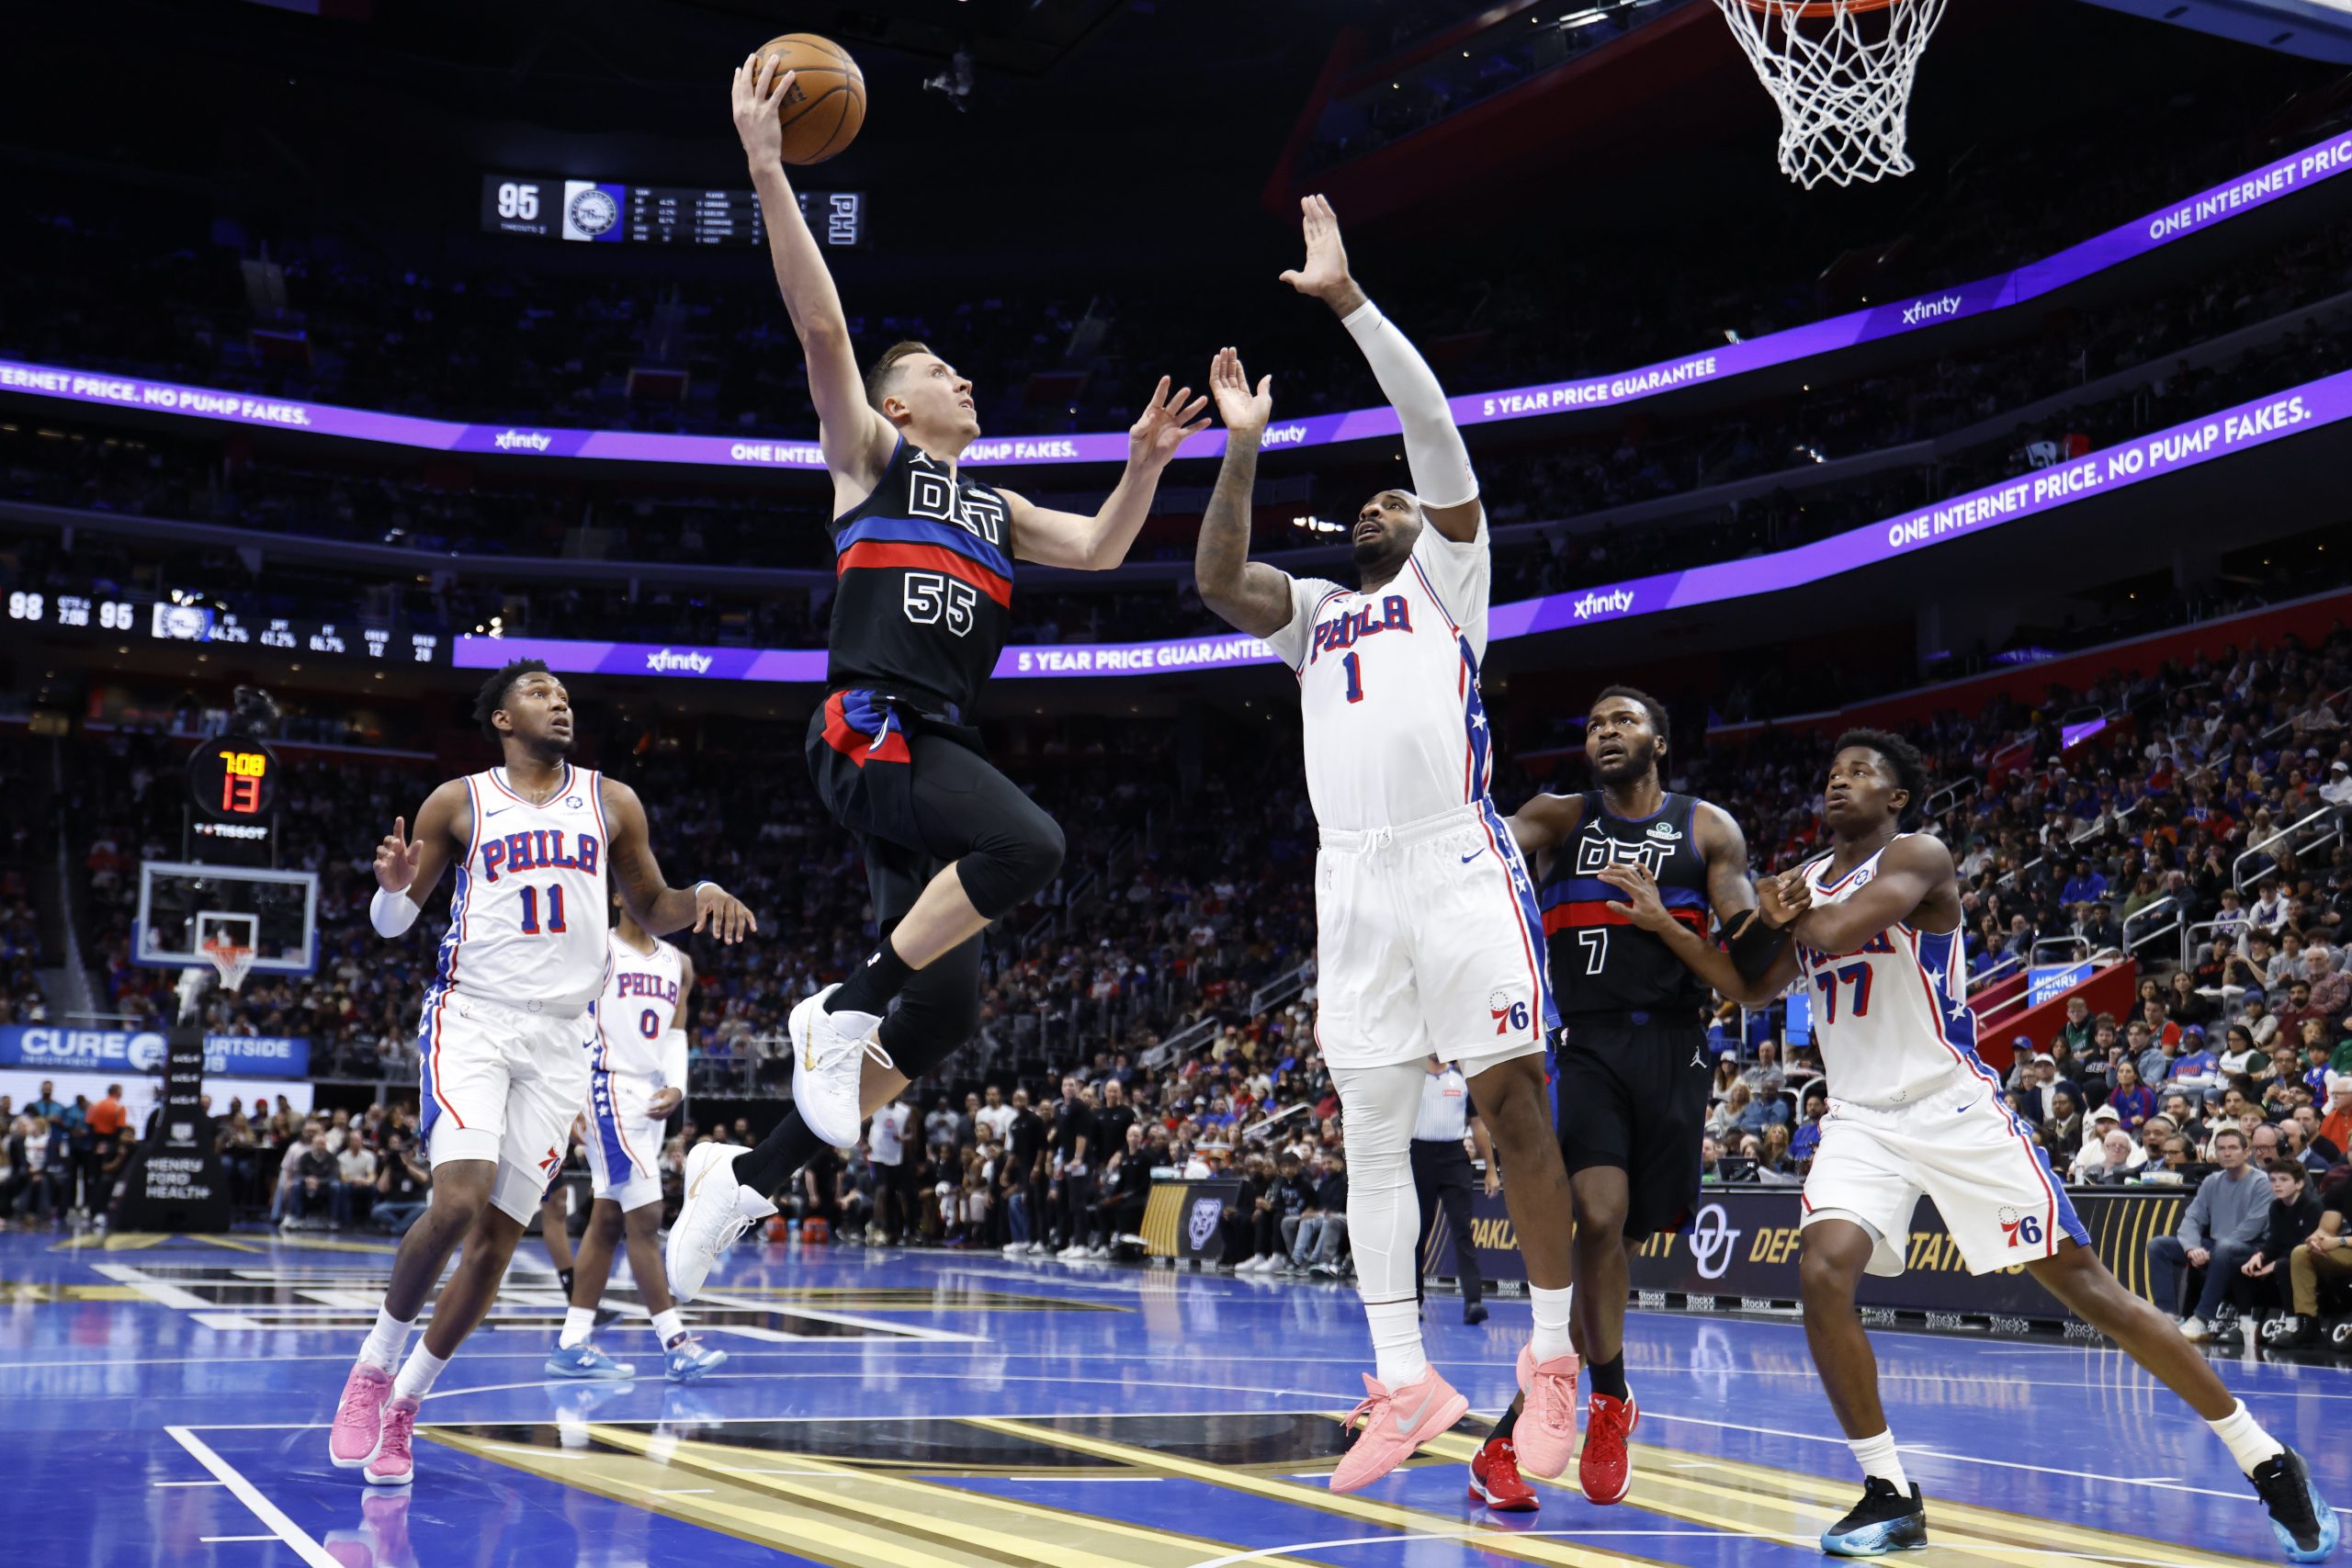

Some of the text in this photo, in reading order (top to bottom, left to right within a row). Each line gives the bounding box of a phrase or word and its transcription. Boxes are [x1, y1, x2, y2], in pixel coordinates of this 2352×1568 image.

[498, 183, 538, 220] 95
[2149, 141, 2352, 240] ONE INTERNET PRIC
[1902, 296, 1961, 324] xfinity
[73, 377, 141, 402] PRICE.
[143, 387, 177, 407] NO
[179, 391, 240, 415] PUMP
[241, 400, 311, 425] FAKES.
[1483, 356, 1716, 416] 5 YEAR PRICE GUARANTEE
[494, 429, 551, 451] xfinity
[730, 443, 772, 461] ONE
[959, 439, 1079, 461] PUMP FAKES.
[1888, 396, 2312, 547] ONE INTERNET PRICE. NO PUMP FAKES.
[9, 592, 43, 620] 98
[100, 602, 133, 629] 95
[904, 572, 977, 637] 55
[1573, 590, 1634, 619] xfinity
[646, 648, 712, 673] xfinity
[1018, 652, 1033, 671] 5
[1035, 651, 1092, 671] YEAR
[1096, 649, 1154, 669] PRICE
[1342, 651, 1363, 704] 1
[220, 751, 266, 777] 7:08
[223, 774, 260, 813] 13
[481, 830, 599, 883] PHILA
[520, 884, 566, 934] 11
[1578, 928, 1608, 975] 7
[616, 972, 678, 1008] PHILA
[1815, 961, 1873, 1025] 77
[640, 1009, 659, 1040] 0
[1490, 1001, 1529, 1035] 76
[21, 1028, 126, 1058] CURE
[1748, 1228, 1801, 1264] DEF
[2000, 1215, 2042, 1247] 76
[1497, 1279, 1520, 1291] StockX
[1638, 1291, 1666, 1302] StockX
[1686, 1294, 1714, 1305] StockX
[1741, 1297, 1770, 1310] StockX
[1861, 1307, 1896, 1320] StockX
[1926, 1312, 1962, 1325] StockX
